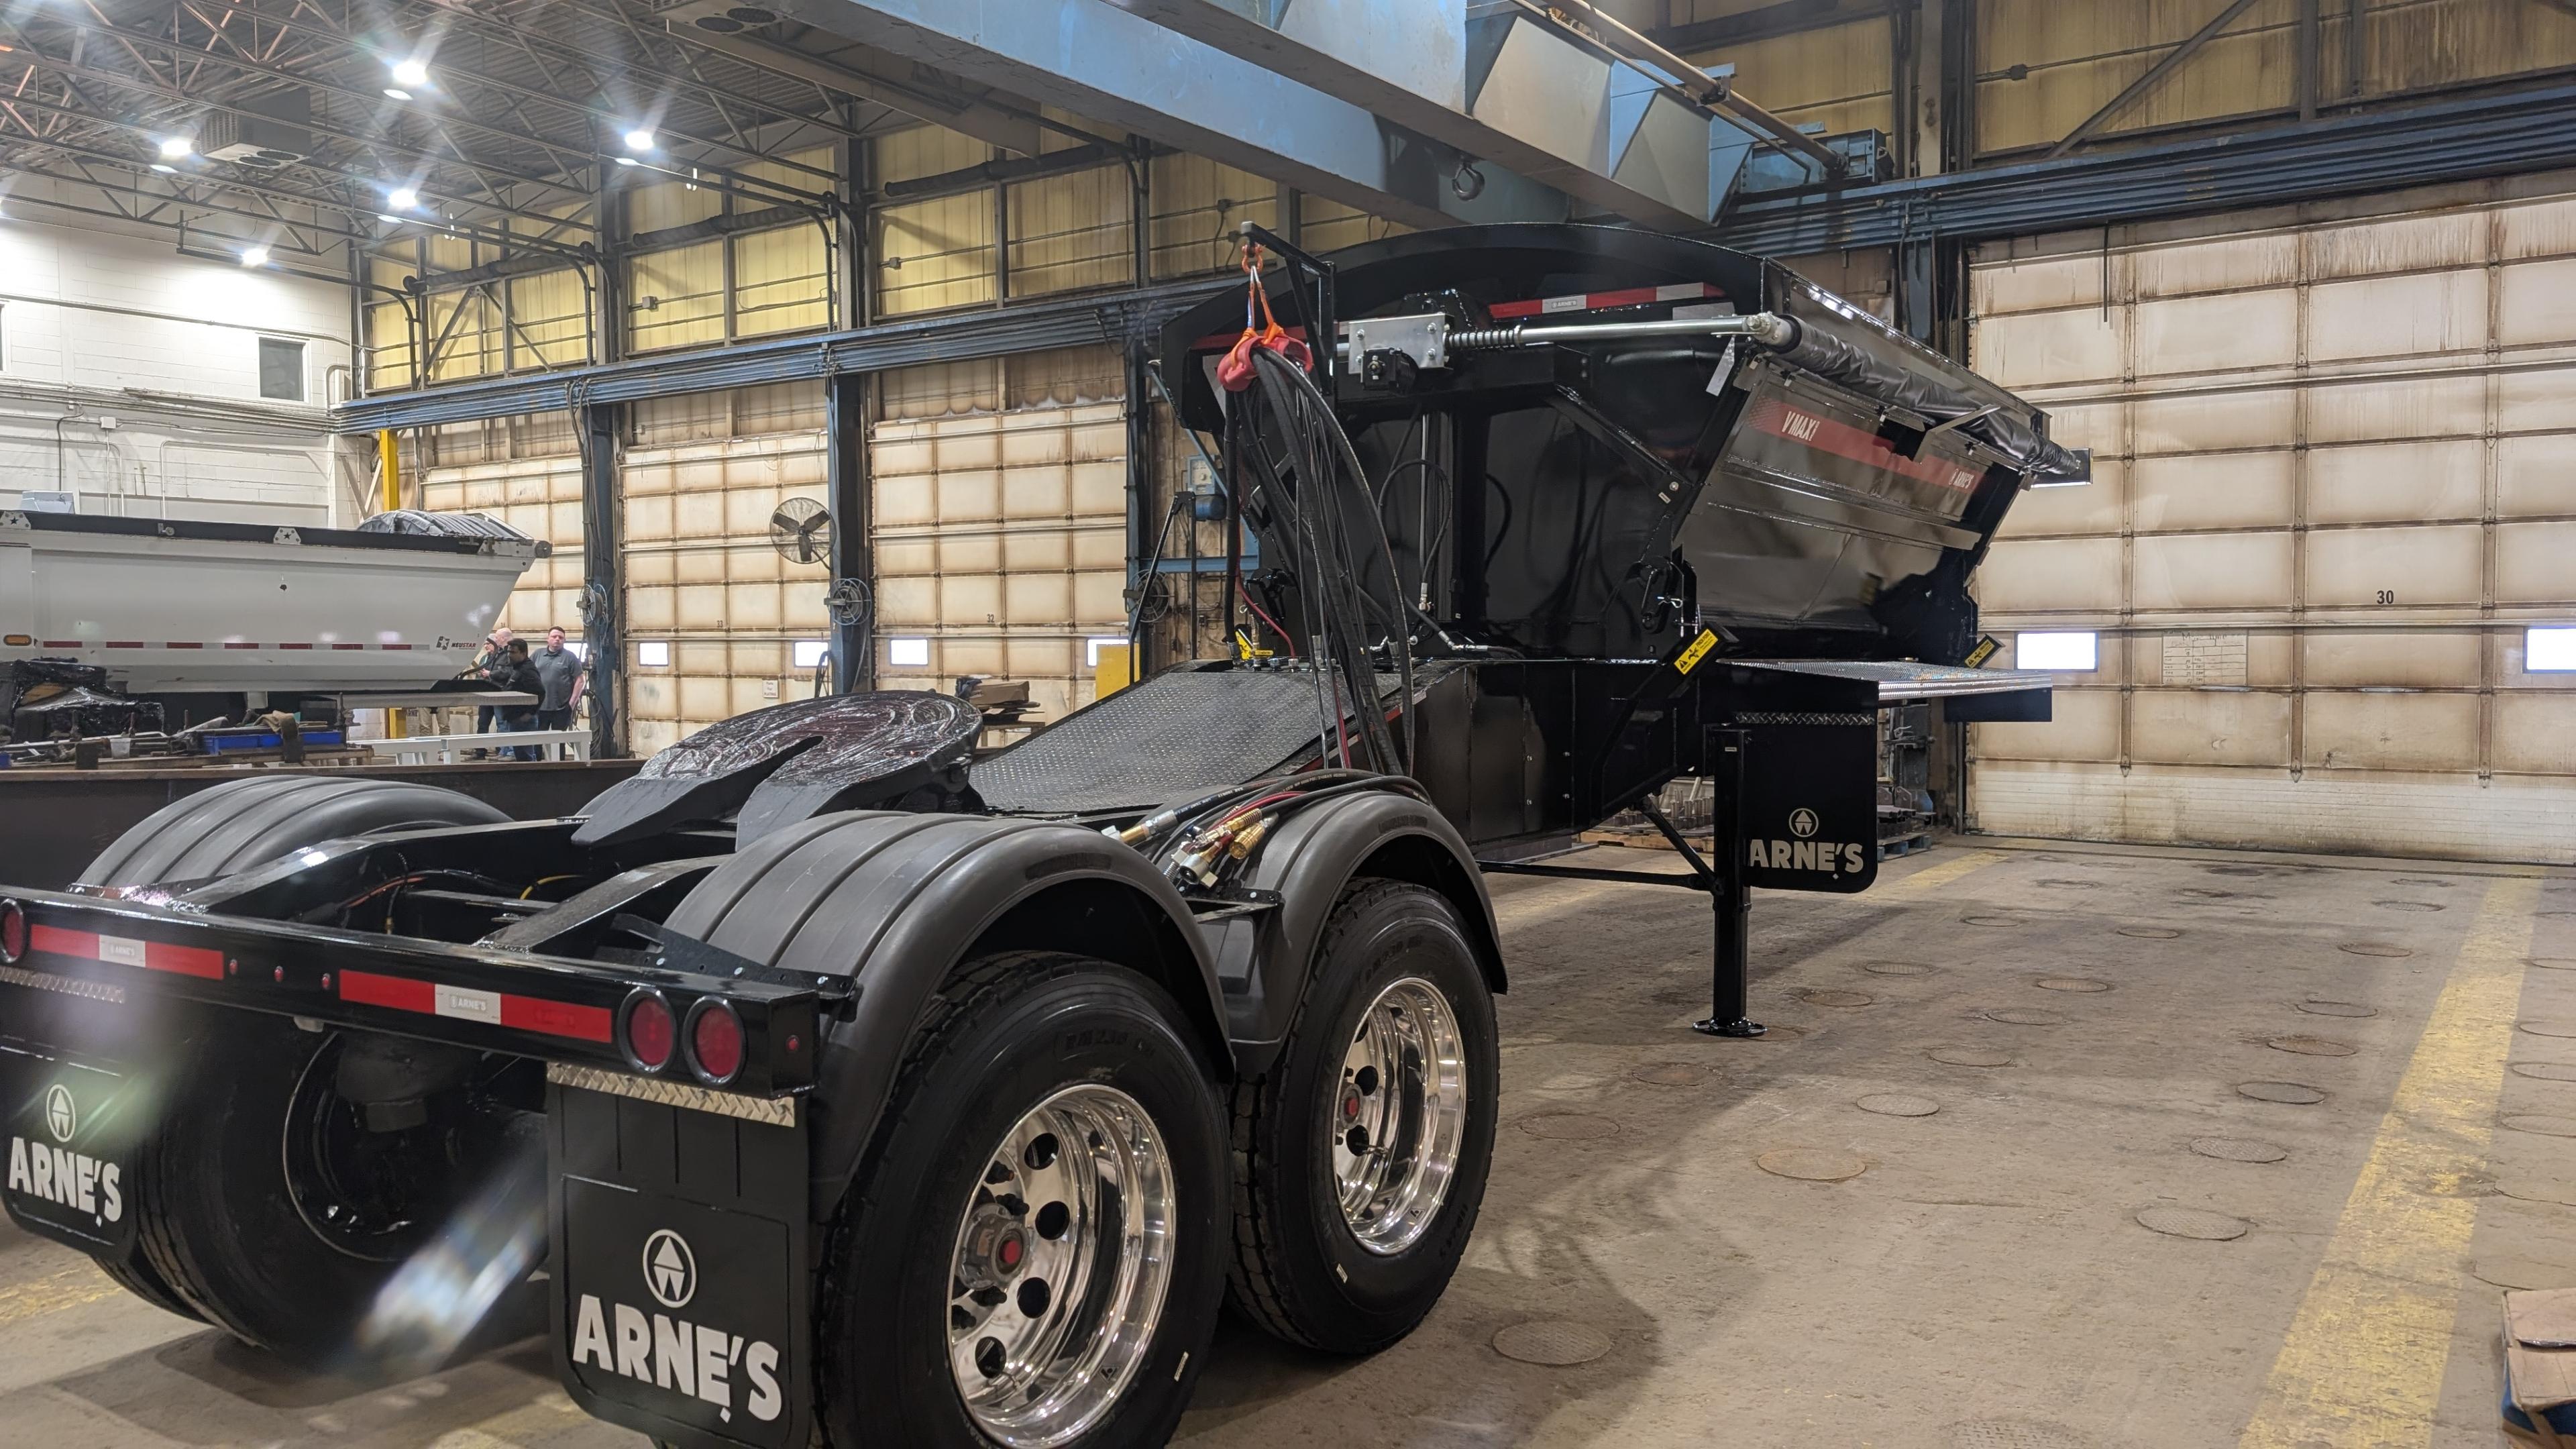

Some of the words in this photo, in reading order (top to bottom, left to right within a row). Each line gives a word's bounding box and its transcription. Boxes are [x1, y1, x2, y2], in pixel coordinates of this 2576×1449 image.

[2377, 590, 2394, 604] 30
[717, 620, 723, 628] 33
[987, 614, 994, 623] 32
[1750, 839, 1864, 873] ARNE'S
[458, 997, 486, 1012] ARNE'S
[9, 1136, 122, 1222] ARNE'S
[573, 1293, 782, 1421] ARNE'S
